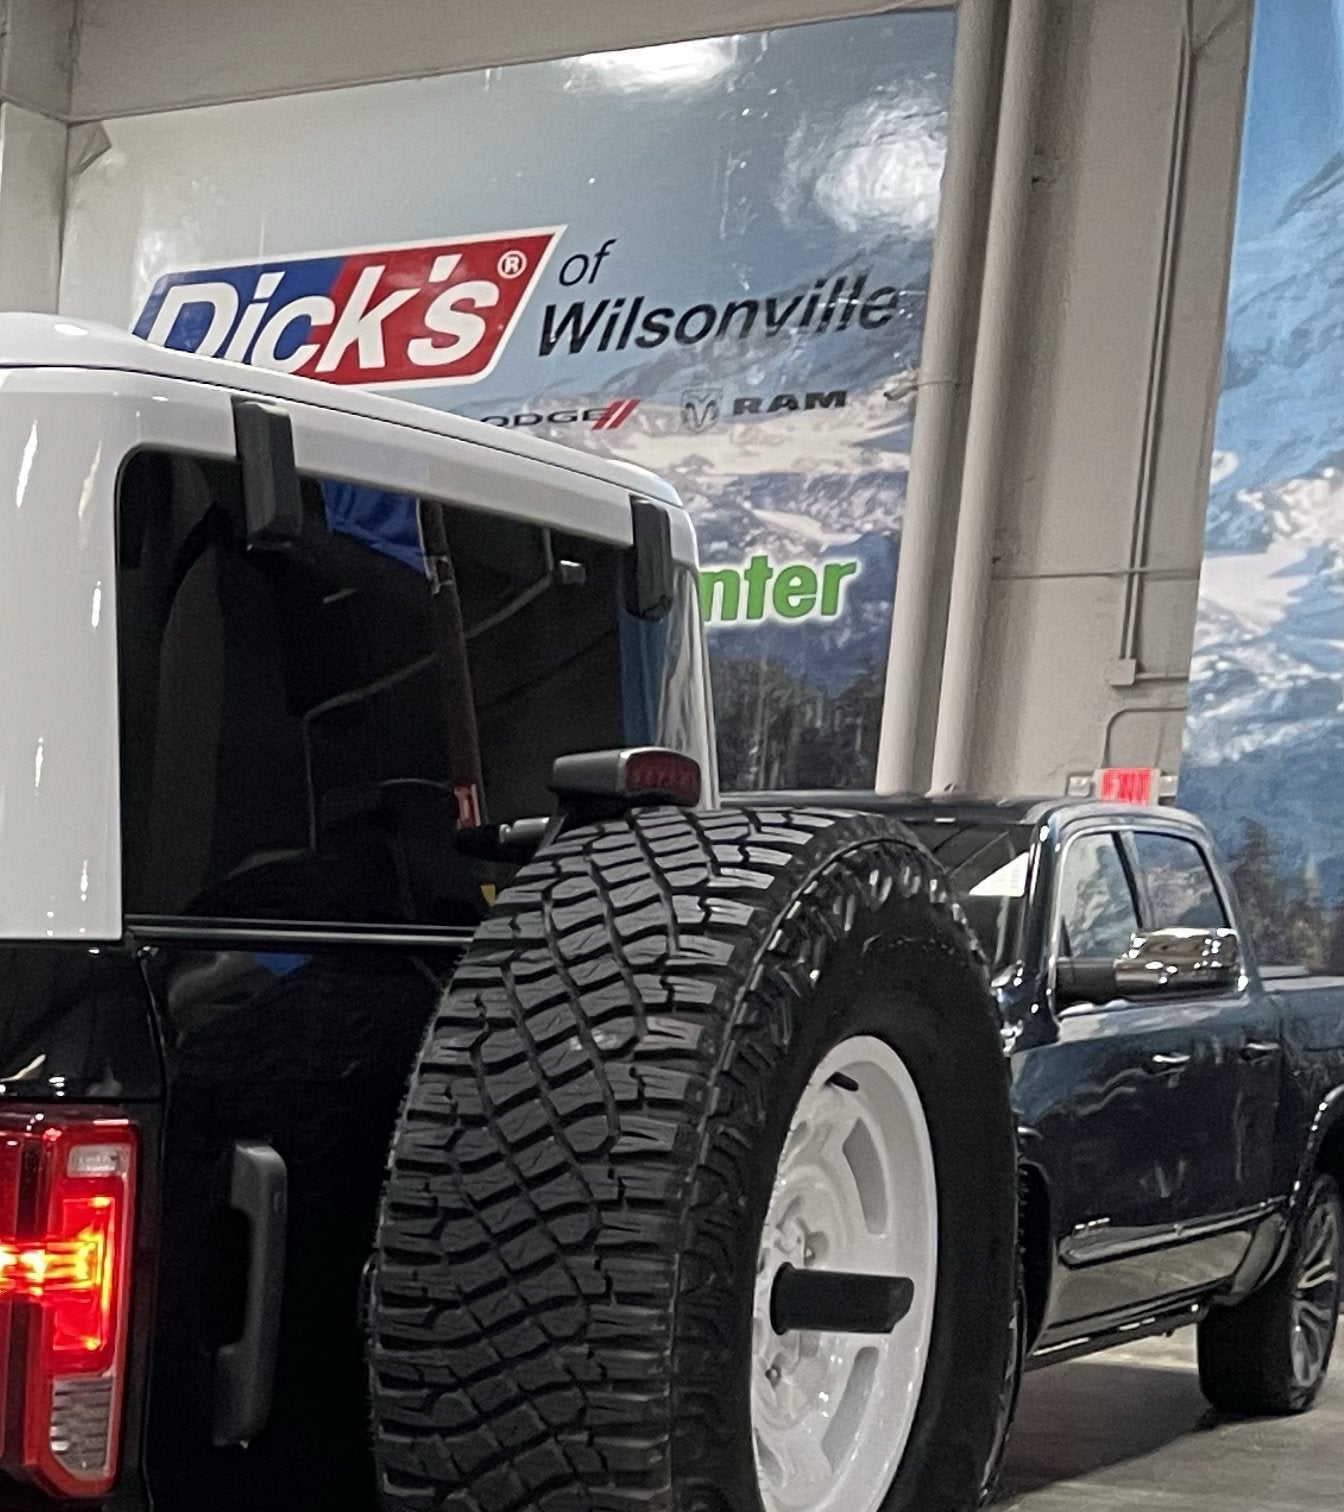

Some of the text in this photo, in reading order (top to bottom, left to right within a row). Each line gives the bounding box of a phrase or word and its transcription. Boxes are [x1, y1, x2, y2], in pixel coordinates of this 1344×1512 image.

[558, 239, 617, 286] of
[539, 273, 899, 356] Wilsonville
[733, 390, 847, 415] RAM
